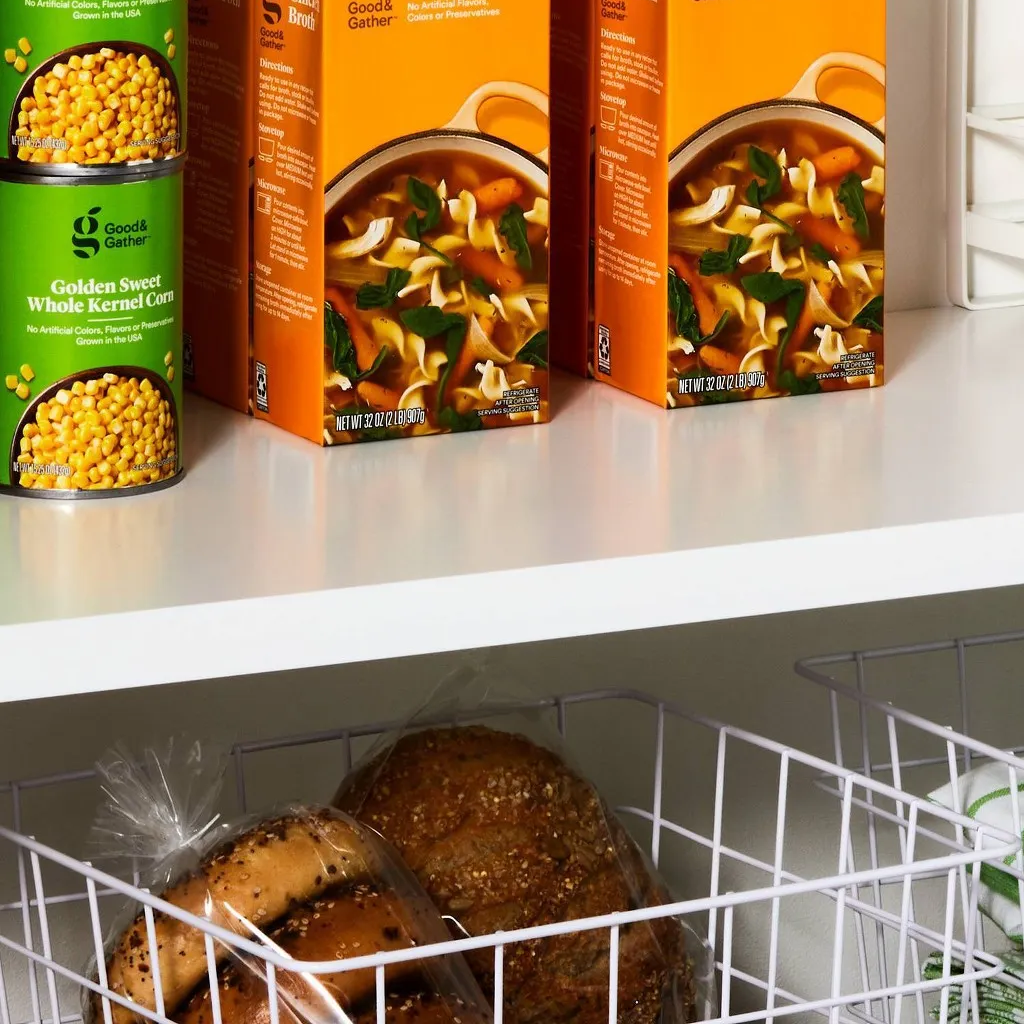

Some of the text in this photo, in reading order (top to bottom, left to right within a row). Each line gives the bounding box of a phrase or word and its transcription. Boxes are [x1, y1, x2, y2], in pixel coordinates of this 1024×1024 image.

[37, 0, 69, 9] Artificial
[71, 0, 100, 10] Colors,
[102, 0, 129, 8] Flavors
[131, 0, 138, 7] or
[407, 2, 419, 11] No
[422, 0, 455, 10] Artificial
[72, 9, 141, 20] Grown in the USA
[288, 5, 316, 31] Broth
[407, 7, 500, 22] Colors or Preservatives
[601, 8, 626, 21] Gather
[348, 15, 392, 30] Gather
[260, 26, 284, 40] Good&
[600, 27, 636, 45] Directions
[260, 37, 284, 51] Gather
[260, 57, 294, 75] Directions
[104, 219, 148, 234] Good&
[104, 235, 147, 249] Gather
[50, 274, 161, 295] Golden Sweet
[27, 290, 174, 313] Whole Kernel Corn
[26, 316, 174, 335] No Artificial Colors, Flavors or Preservatives
[76, 333, 142, 346] Grown in the USA
[840, 351, 876, 361] REFRIGERATE
[832, 359, 876, 370] AFTER OPENING
[815, 367, 875, 381] SERVING SUGGESTION
[678, 371, 765, 394] NET WT 32 OZ (2 LB) 907g
[502, 387, 540, 398] REFRIGERATE
[494, 395, 540, 407] AFTER OPENING
[477, 403, 540, 417] SERVING SUGGESTION
[336, 408, 425, 431] NET WT 32 OZ (2 LB) 907g
